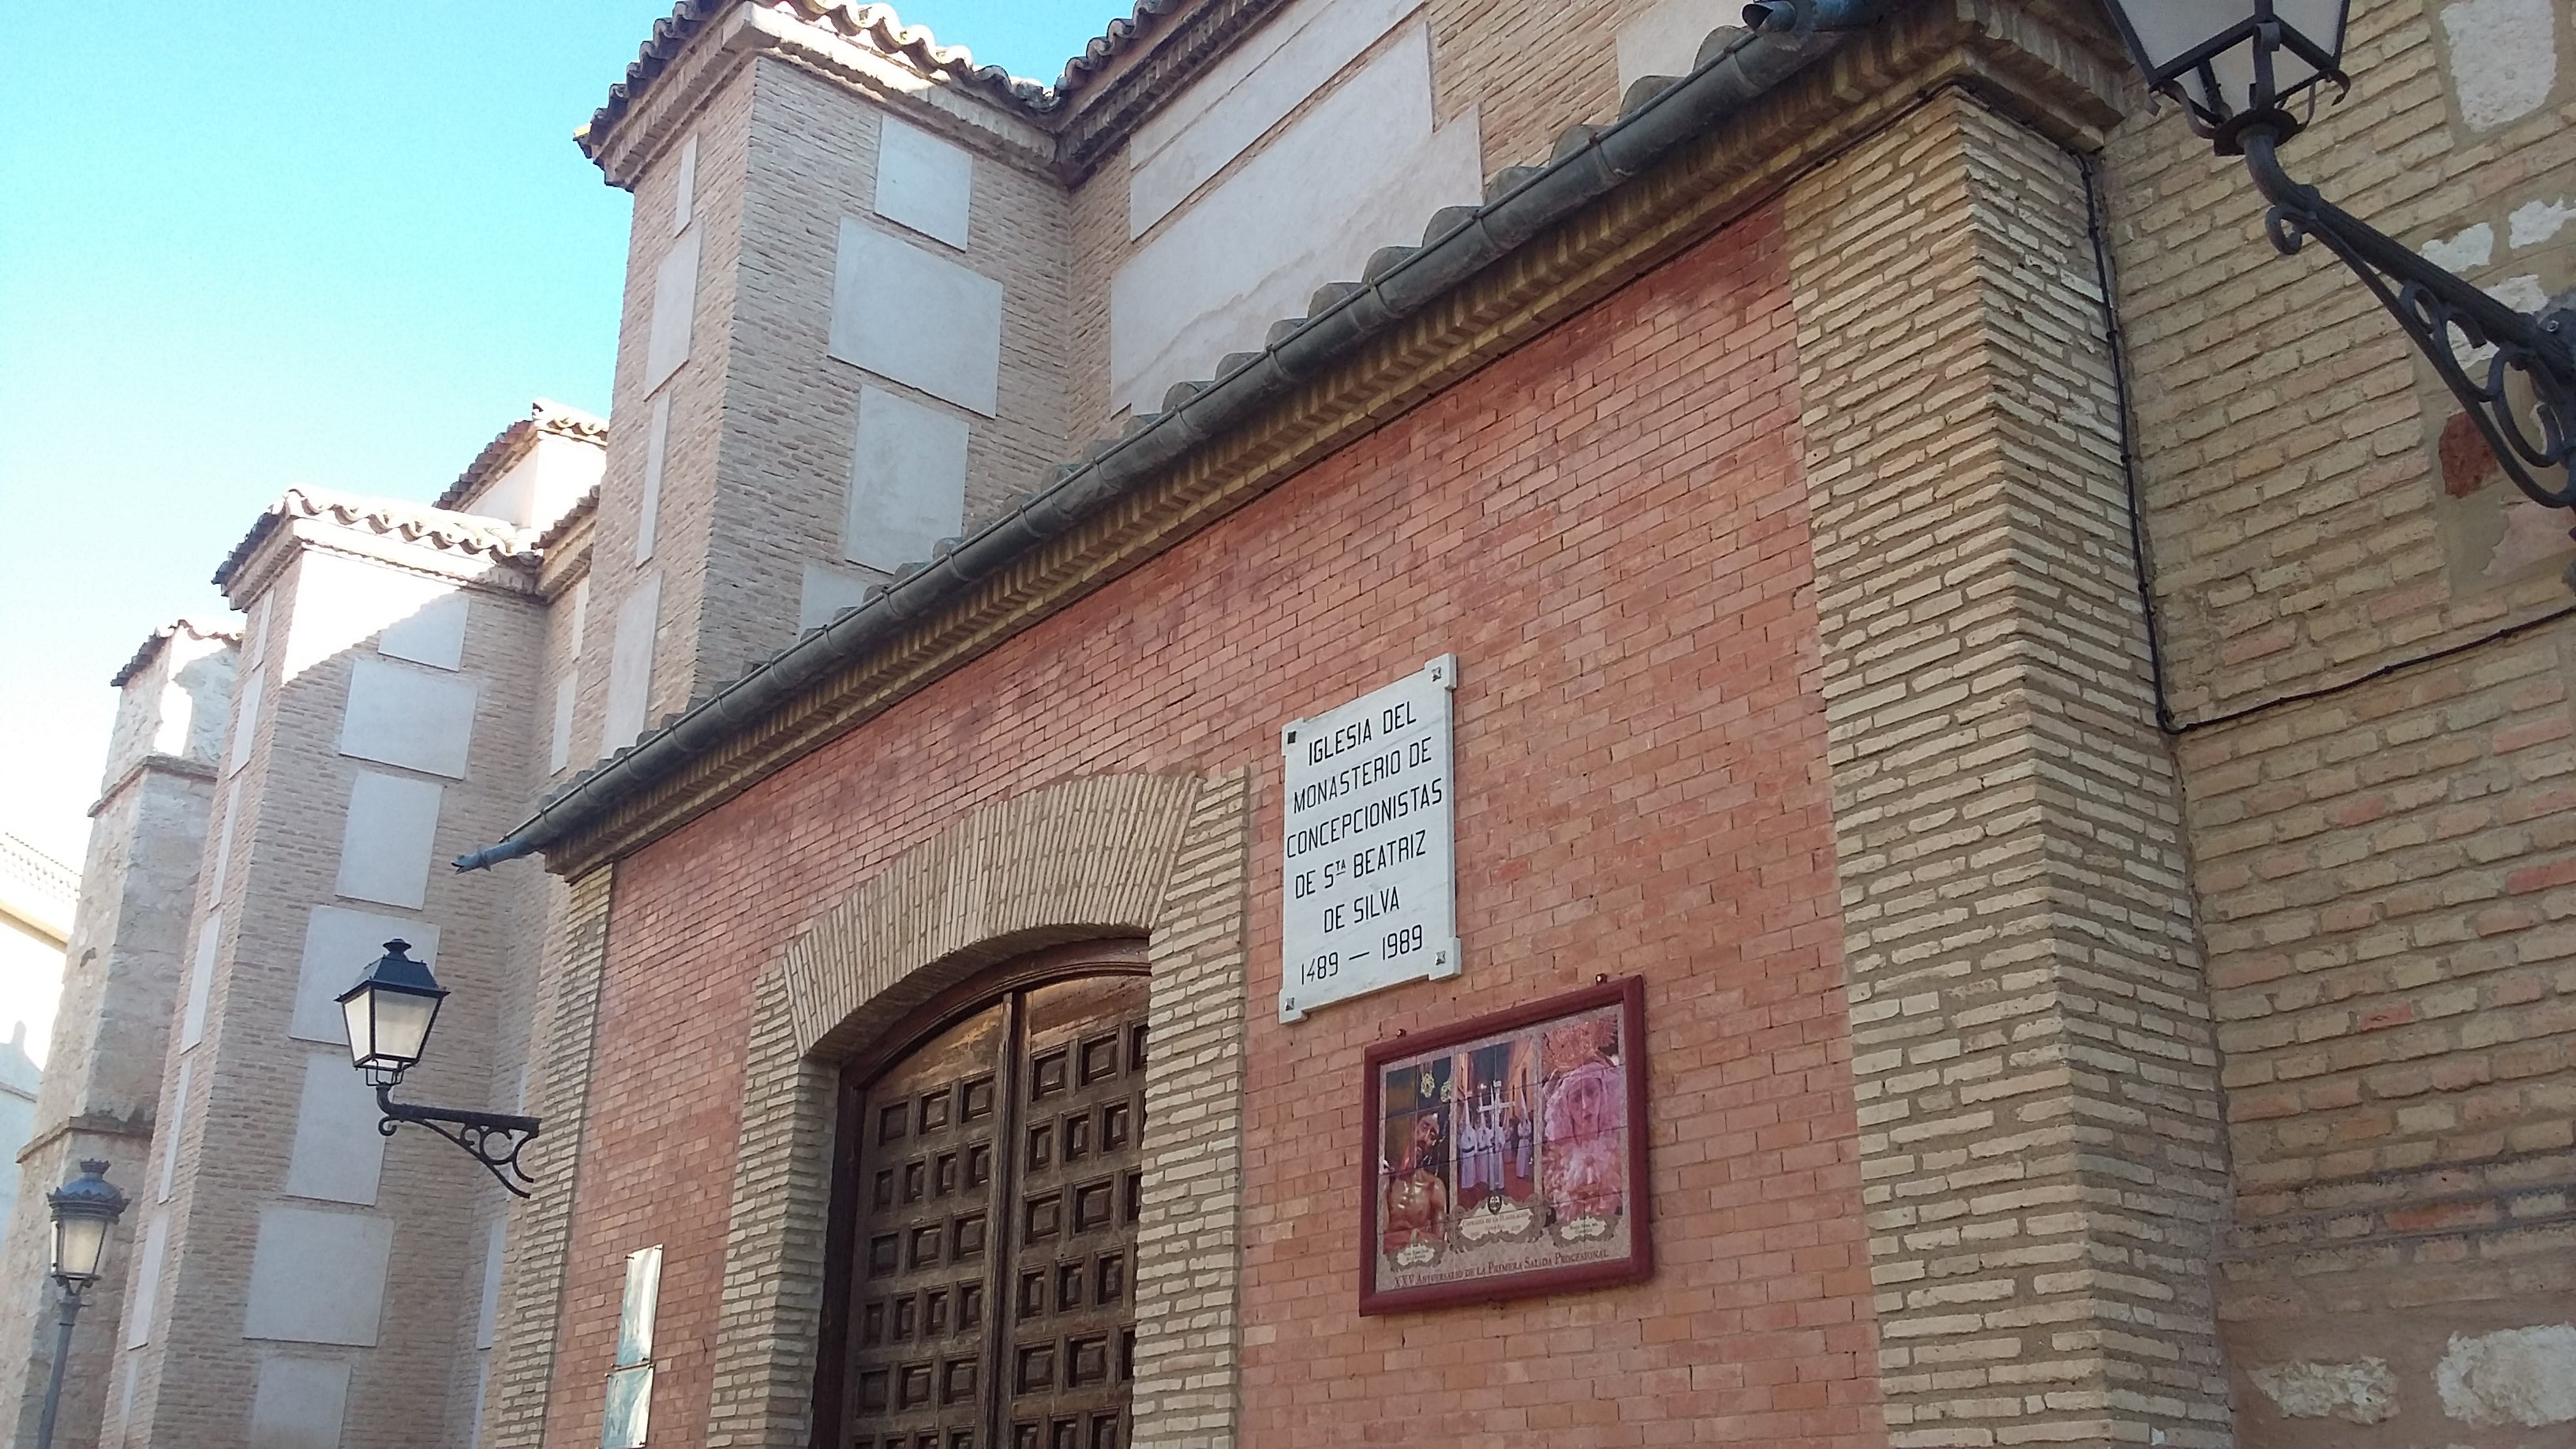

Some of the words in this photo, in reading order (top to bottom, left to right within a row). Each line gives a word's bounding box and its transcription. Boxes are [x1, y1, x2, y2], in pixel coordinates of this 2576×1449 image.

[1309, 718, 1372, 766] IGLESIA
[1383, 701, 1417, 735] DEL
[1294, 750, 1401, 814] MONASTERIO
[1409, 736, 1432, 769] DE
[1286, 777, 1442, 859] CONCEPCIONISTAS
[1295, 869, 1316, 899] DE
[1354, 829, 1426, 878] BEATRIZ
[1324, 904, 1345, 933] DE
[1354, 886, 1400, 923] SILVA
[1301, 952, 1338, 985] 1489
[1382, 924, 1422, 960] 1989
